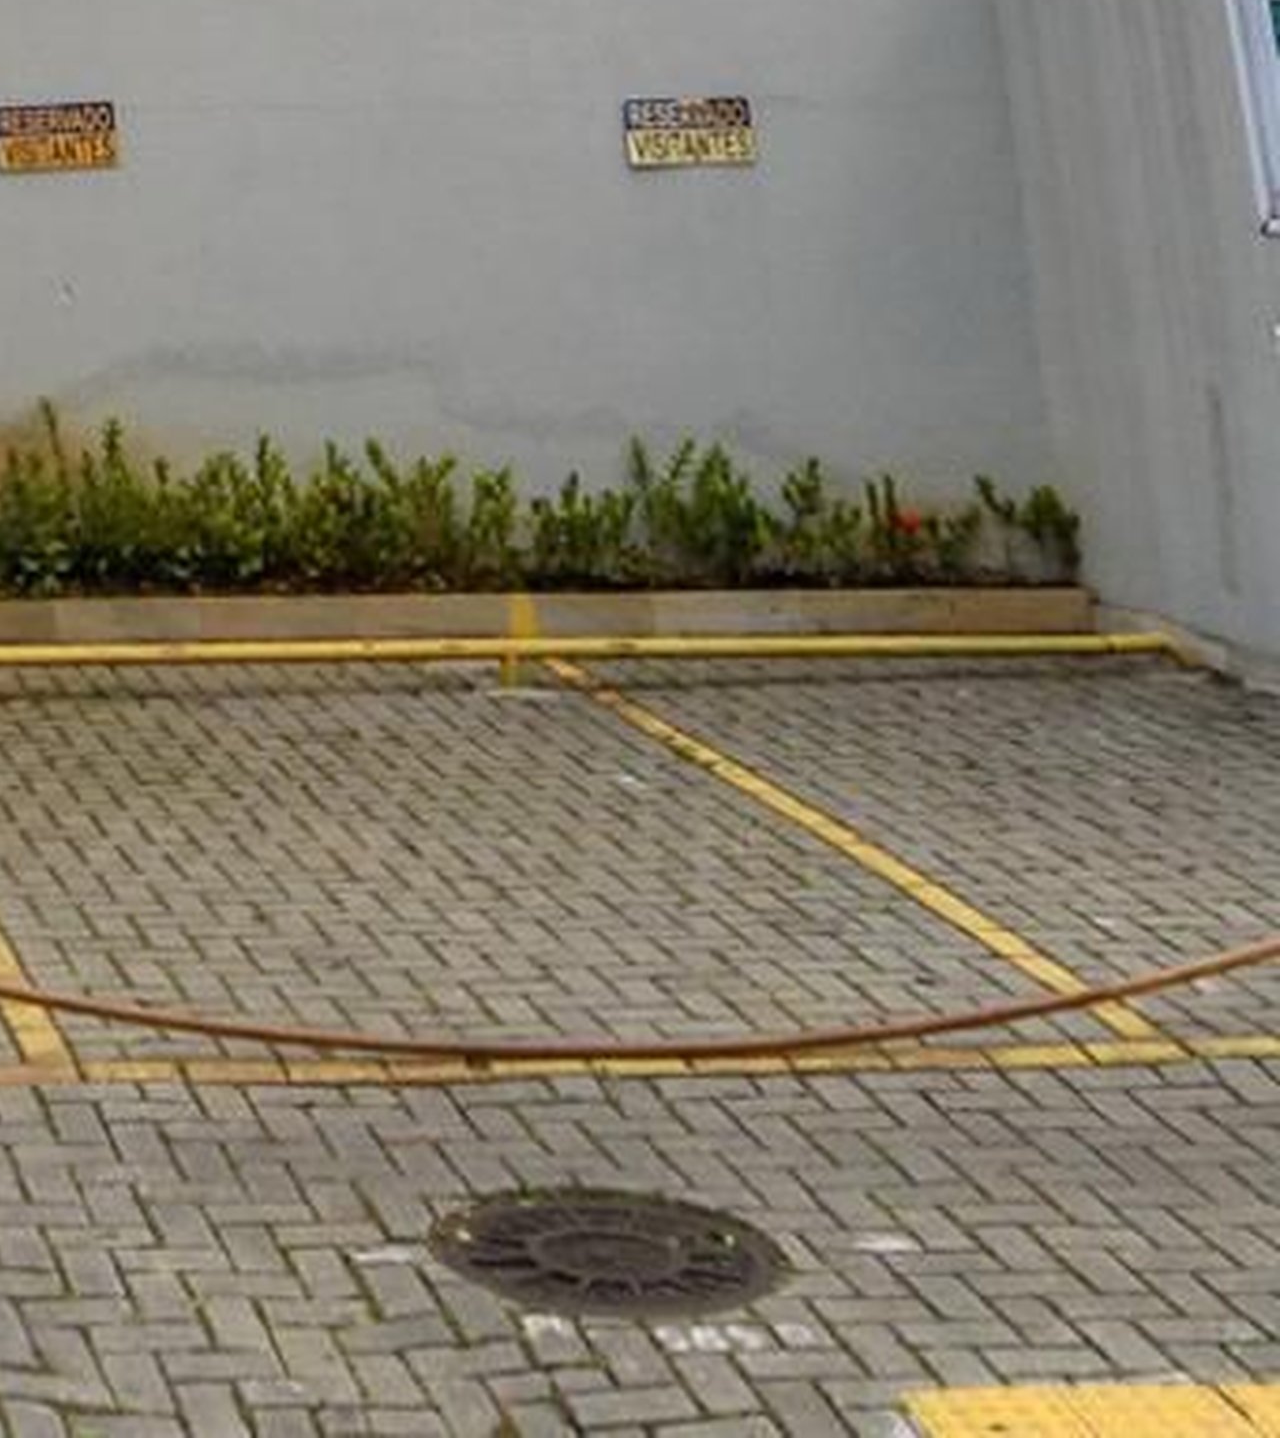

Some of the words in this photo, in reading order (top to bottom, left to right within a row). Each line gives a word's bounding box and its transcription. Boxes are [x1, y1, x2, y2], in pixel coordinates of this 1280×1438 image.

[629, 100, 748, 126] RESERVADO
[2, 132, 115, 164] VISITANTES
[633, 128, 751, 160] VISITANTES
